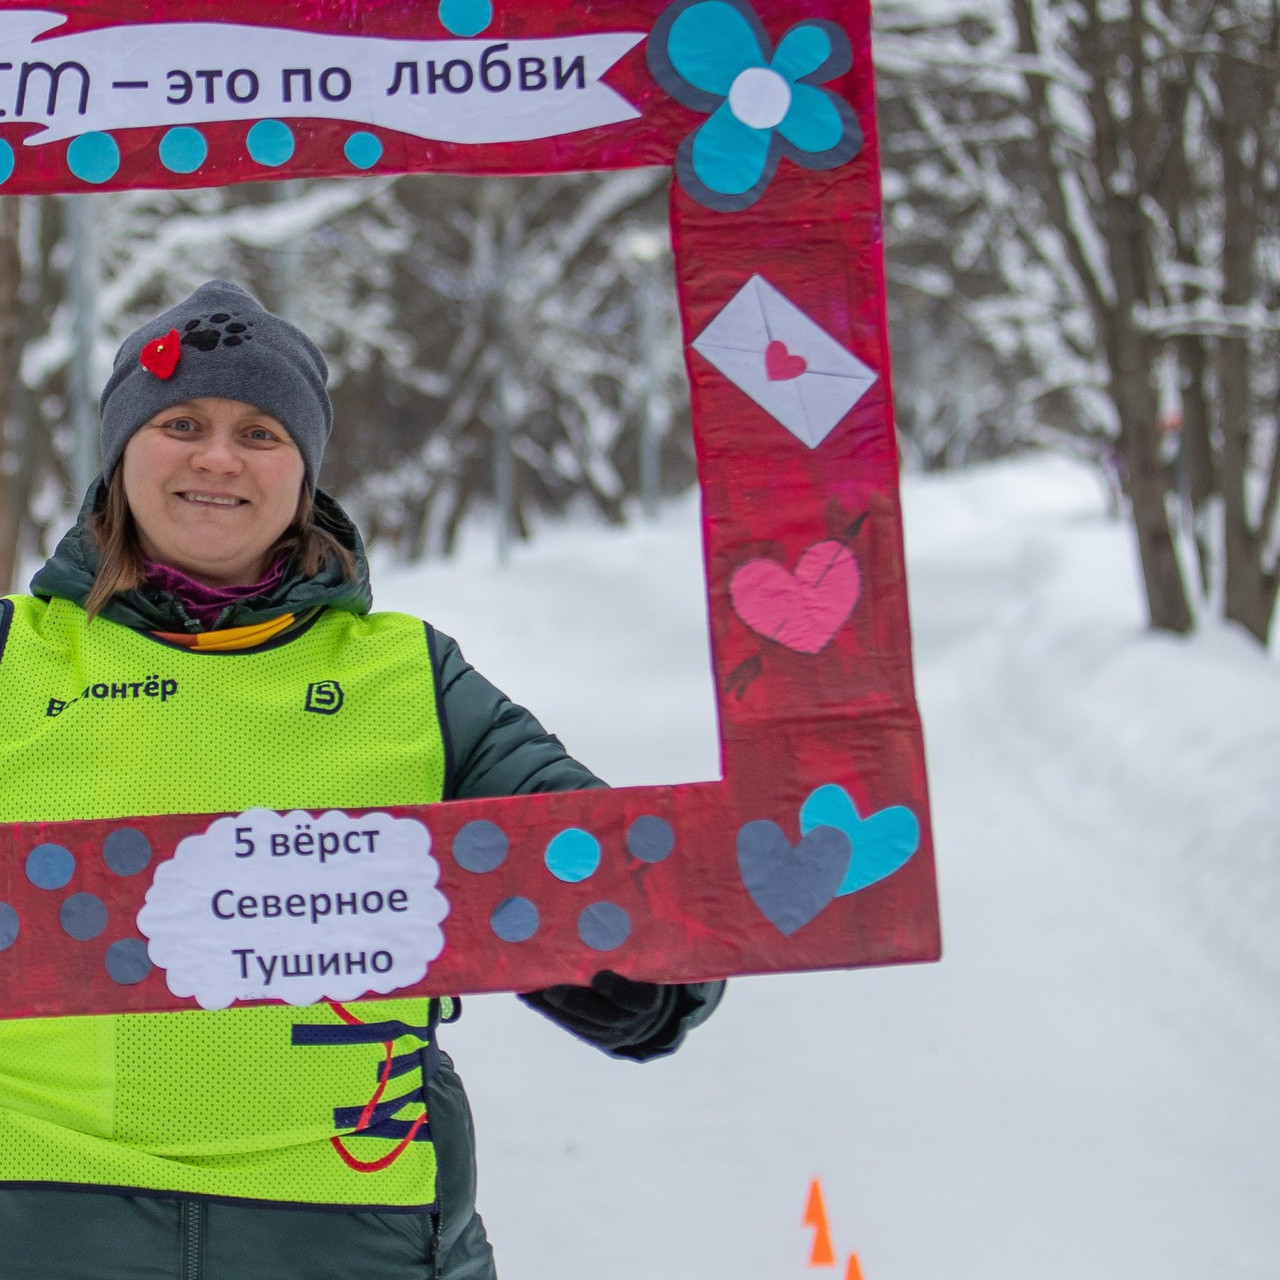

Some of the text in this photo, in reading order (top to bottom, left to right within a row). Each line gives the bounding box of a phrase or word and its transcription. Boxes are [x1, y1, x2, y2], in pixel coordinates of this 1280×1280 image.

[166, 69, 260, 105] это
[281, 66, 352, 103] по
[386, 42, 586, 97] любви
[235, 824, 380, 864] 5 вёрст
[211, 889, 408, 924] Северное
[231, 948, 394, 986] Тушино
